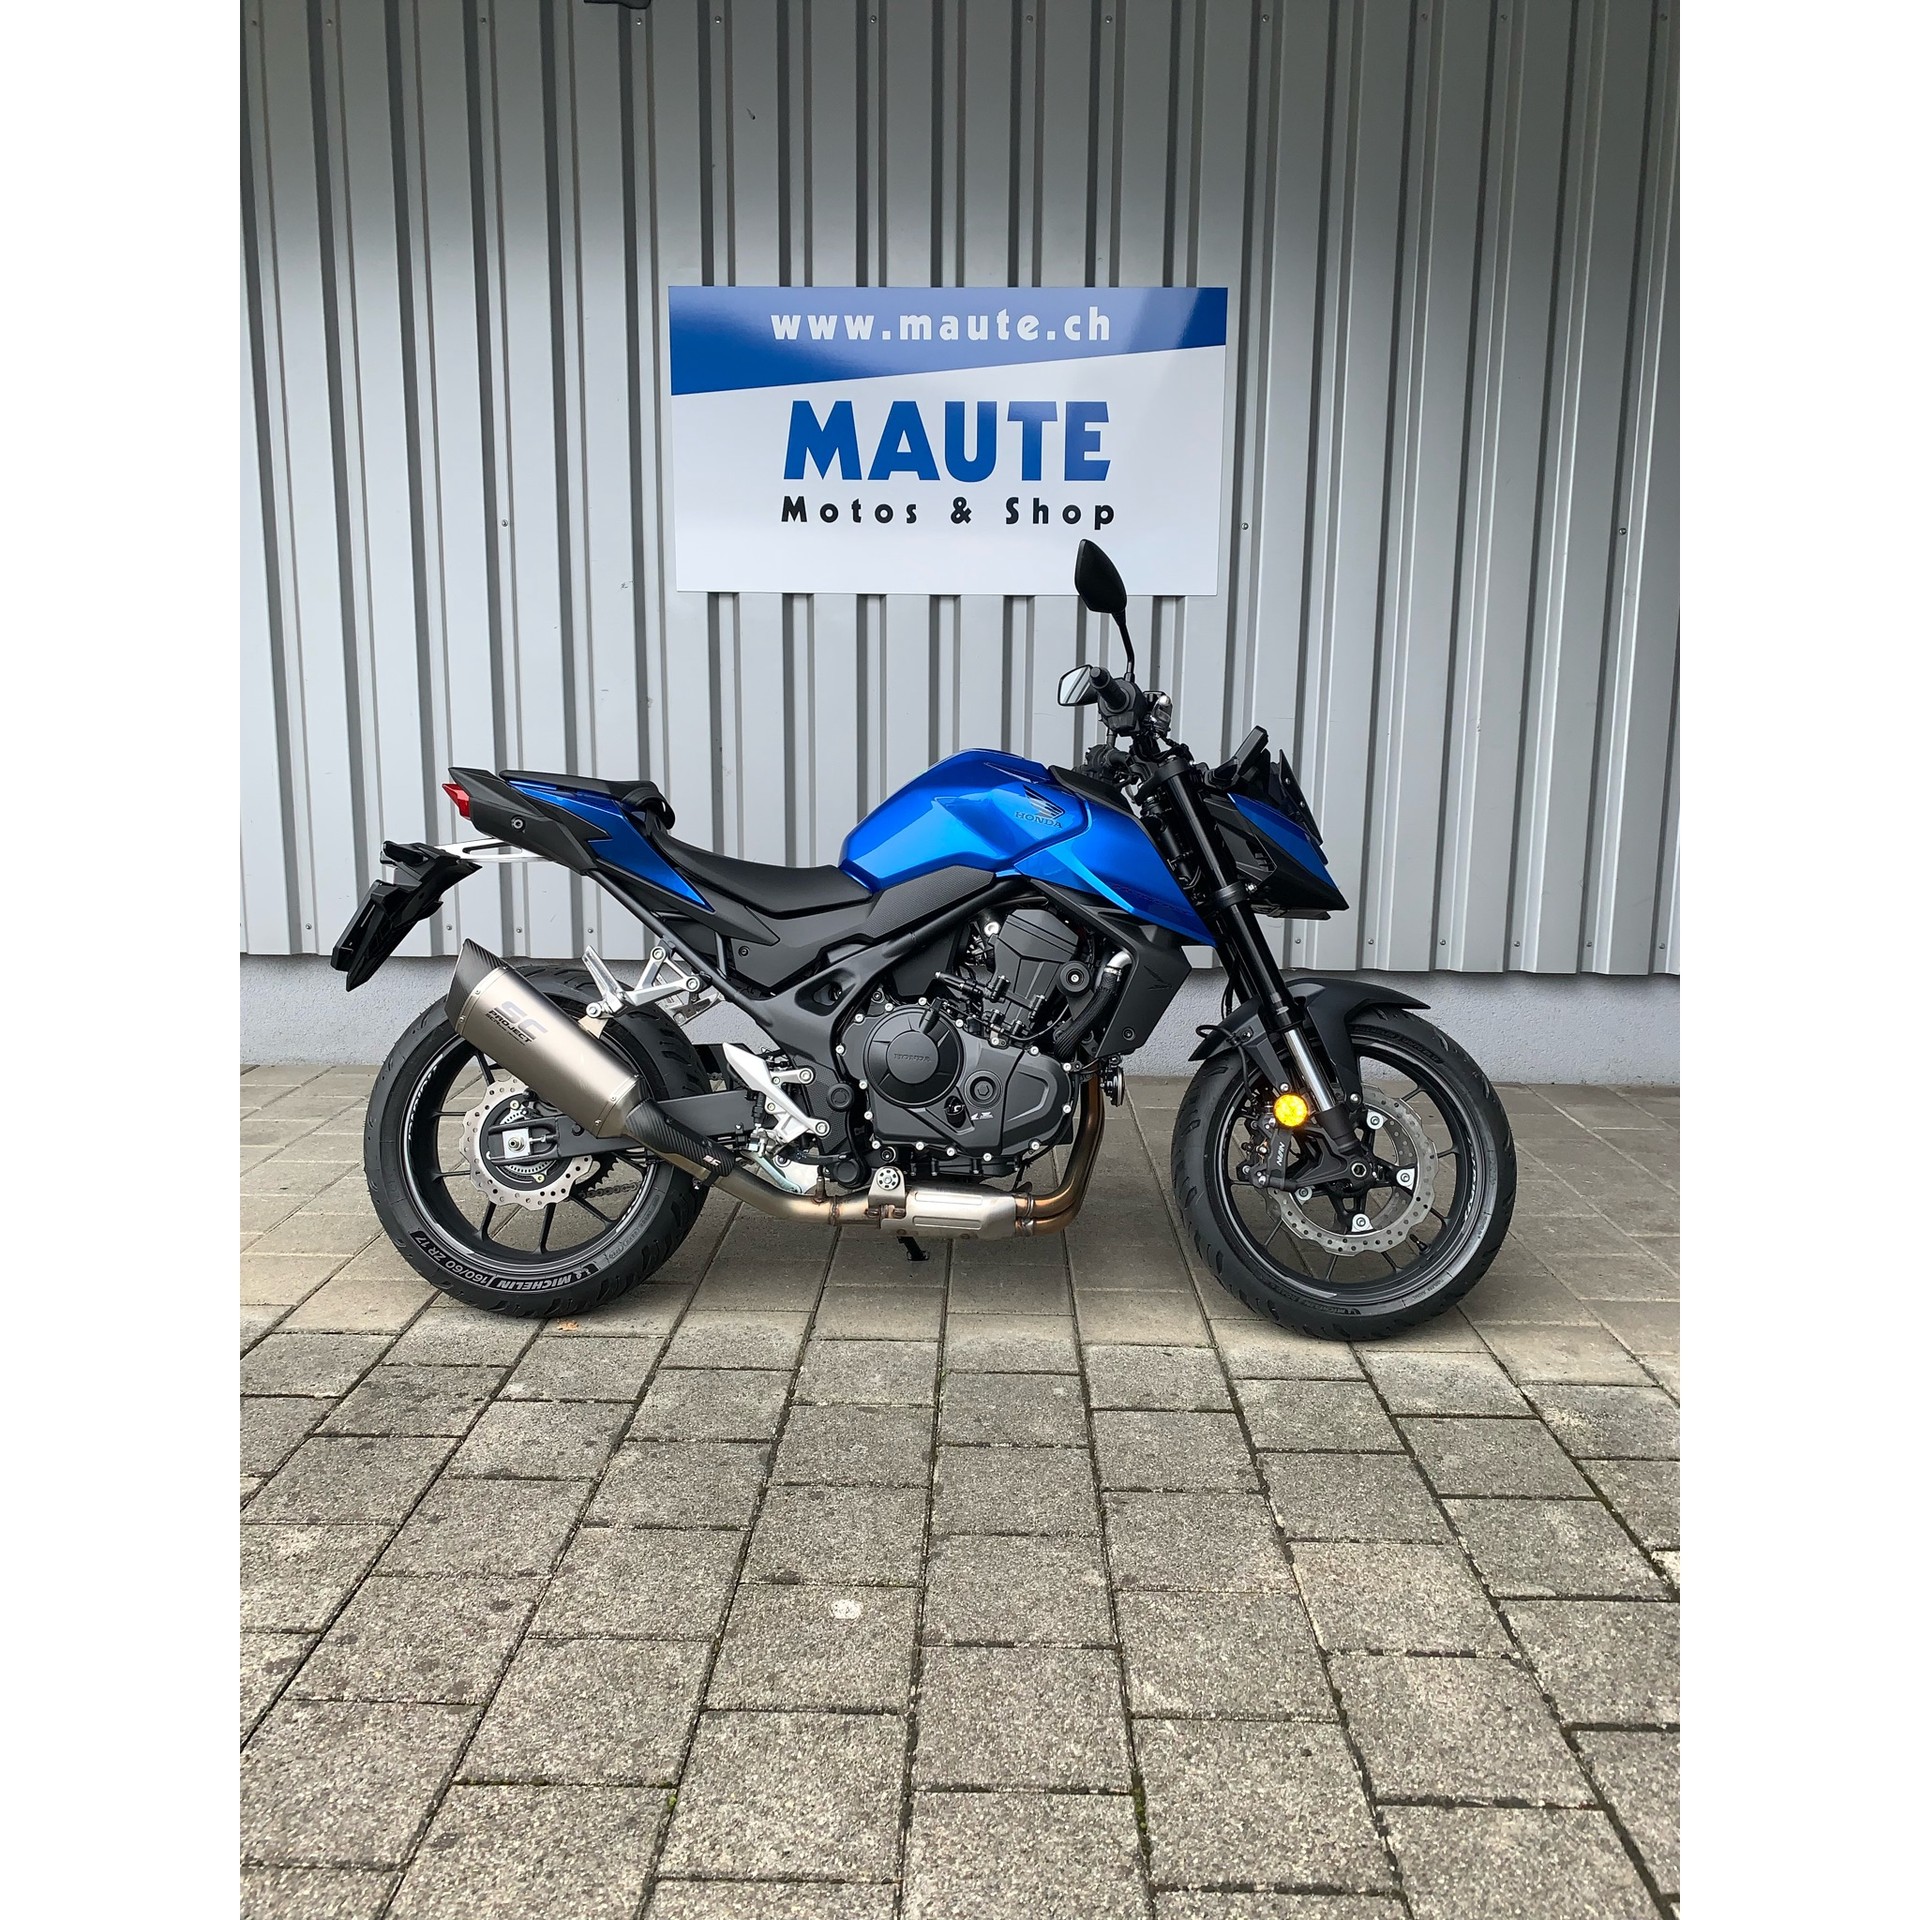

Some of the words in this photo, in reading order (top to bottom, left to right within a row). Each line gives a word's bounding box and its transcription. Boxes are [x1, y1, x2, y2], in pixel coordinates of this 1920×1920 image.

[771, 307, 1111, 341] www.maute.ch
[783, 400, 1111, 483] MAUTE
[780, 495, 917, 524] Motos
[950, 496, 972, 525] &
[1005, 496, 1115, 531] Shop
[1015, 811, 1063, 830] HONDA
[488, 1009, 533, 1043] PROJECT
[493, 1000, 549, 1041] SC
[414, 1235, 430, 1250] 17
[428, 1247, 447, 1262] ZR
[445, 1260, 488, 1285] 160/60
[498, 1274, 572, 1291] MICHELIN
